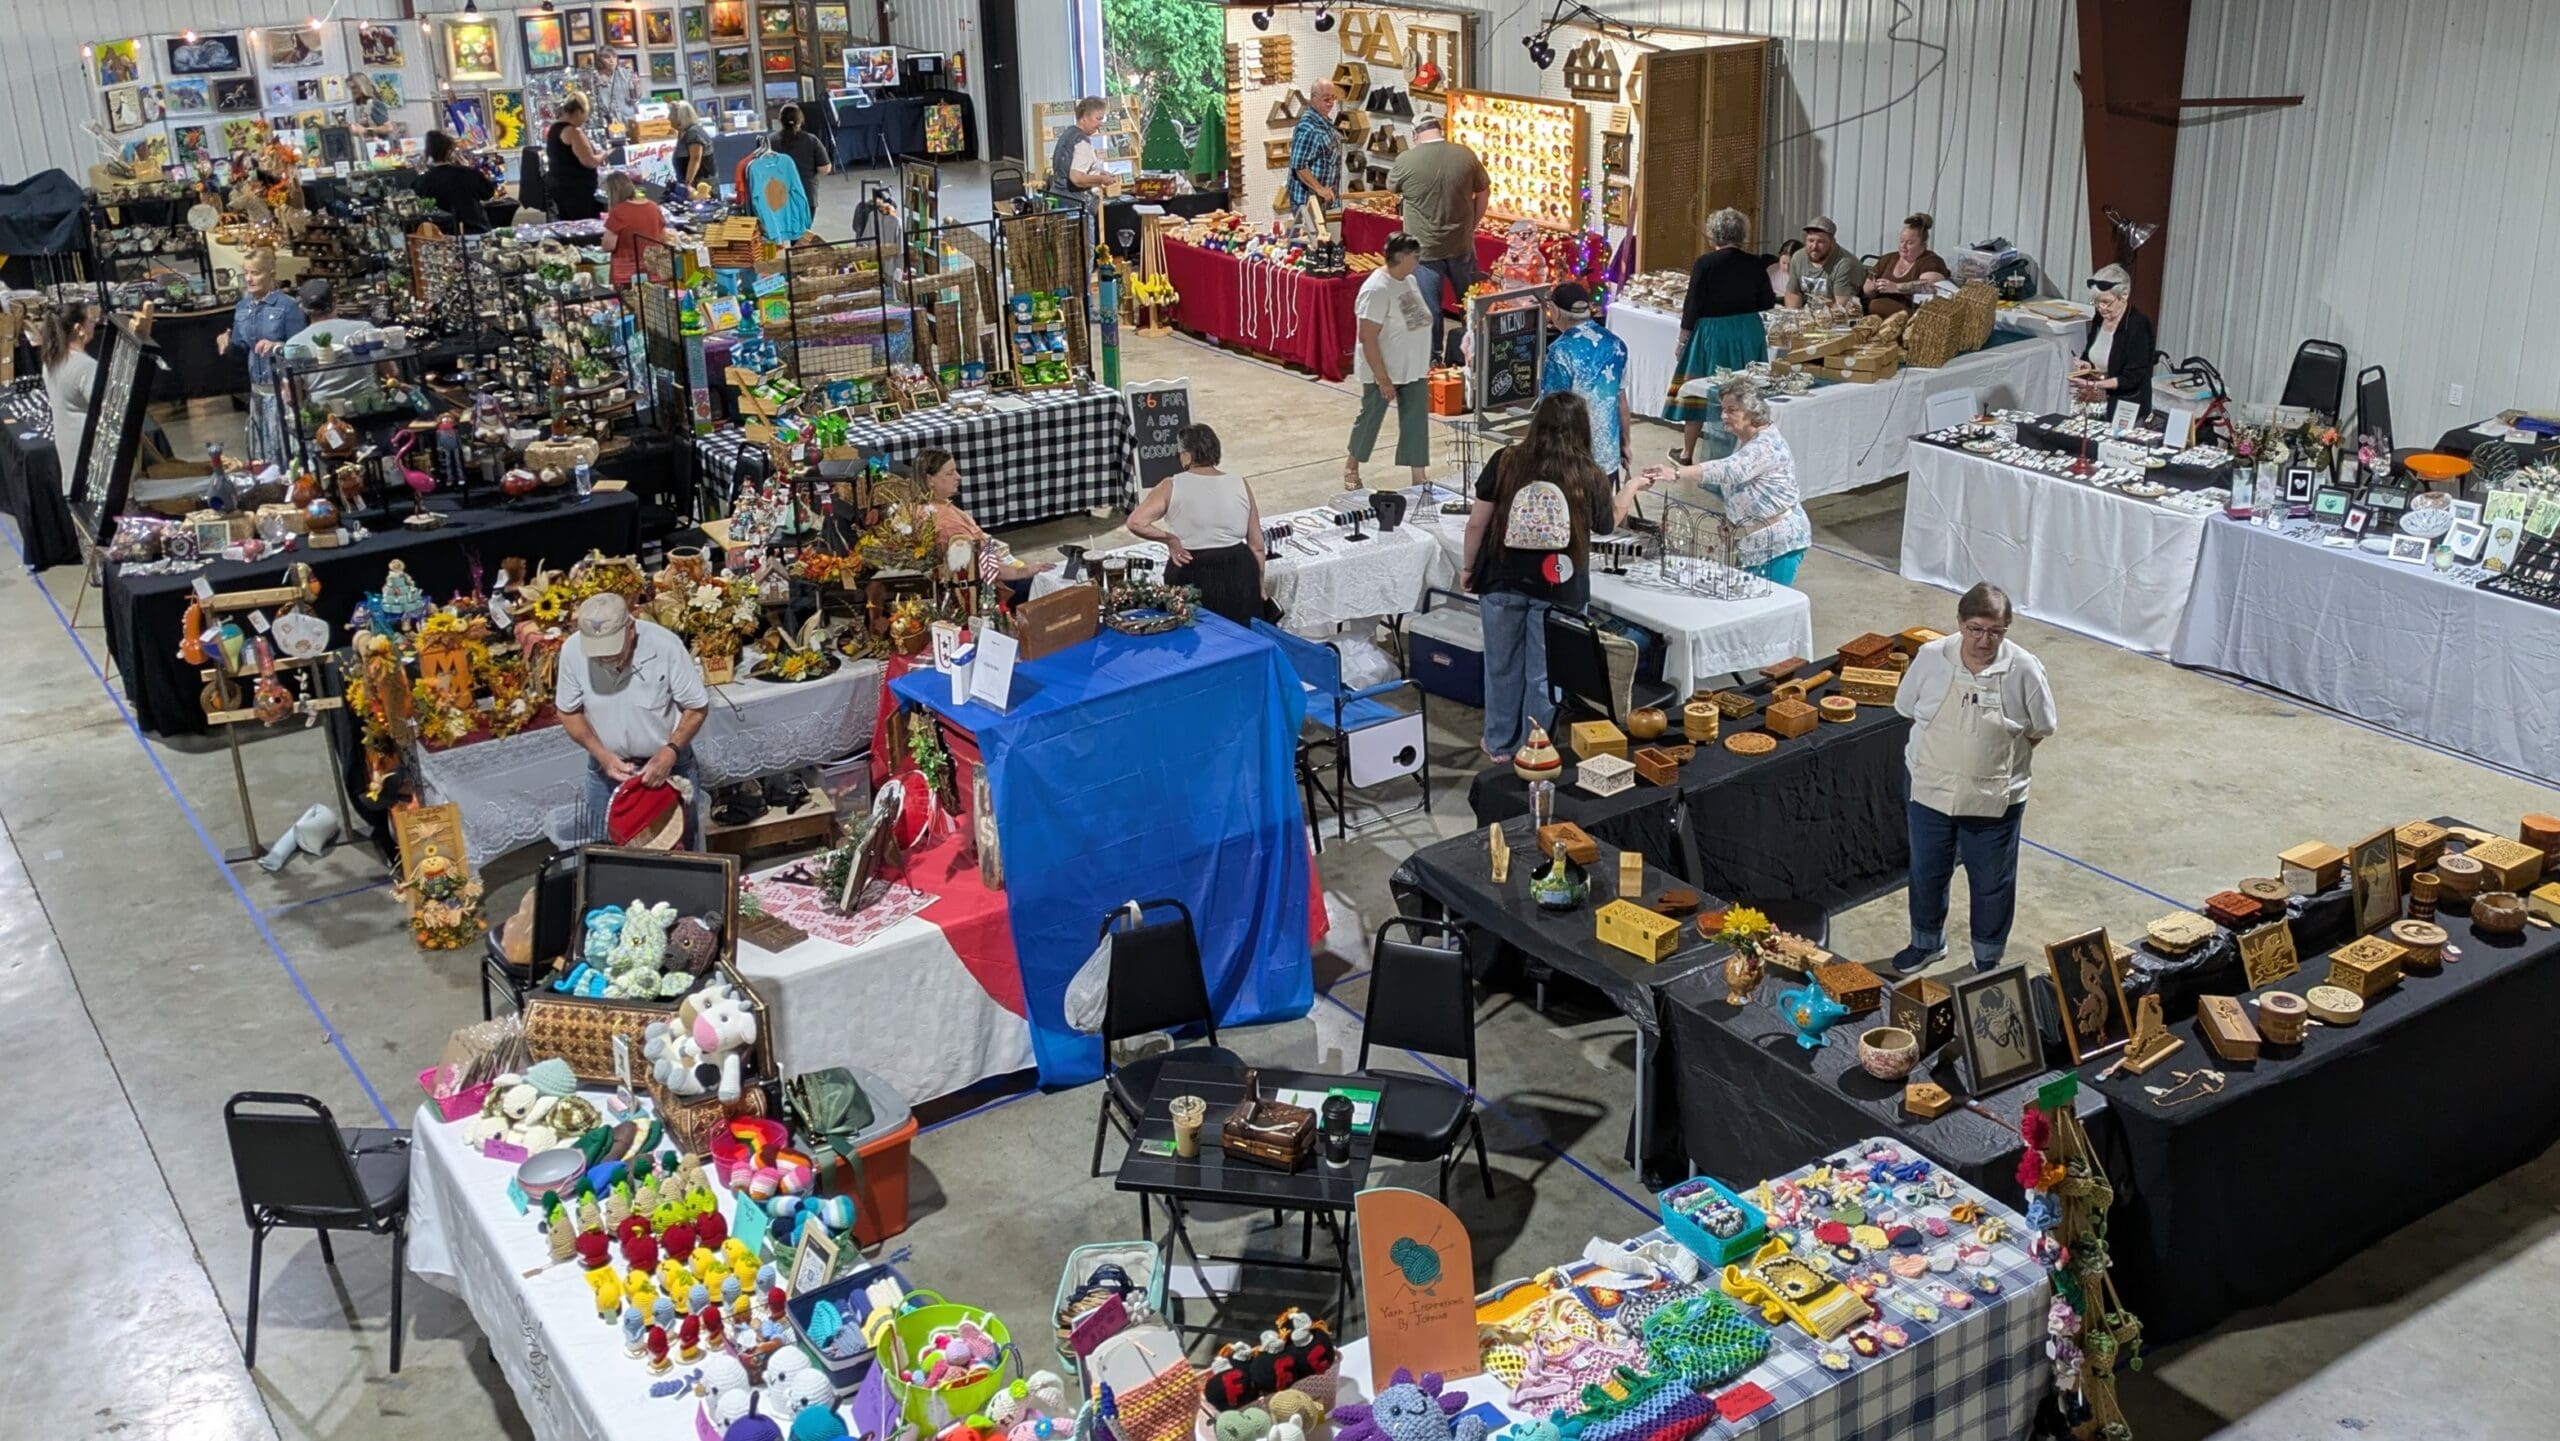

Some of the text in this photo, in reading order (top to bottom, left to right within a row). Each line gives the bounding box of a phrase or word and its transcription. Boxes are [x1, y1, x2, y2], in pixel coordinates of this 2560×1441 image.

[1500, 312, 1525, 335] MENU
[1138, 392, 1185, 410] $6 FOR
[1146, 414, 1179, 426] A BAG
[1152, 429, 1171, 442] OF
[1380, 1306, 1404, 1319] Yarn
[1398, 1318, 1409, 1331] By
[1222, 1368, 1244, 1406] F
